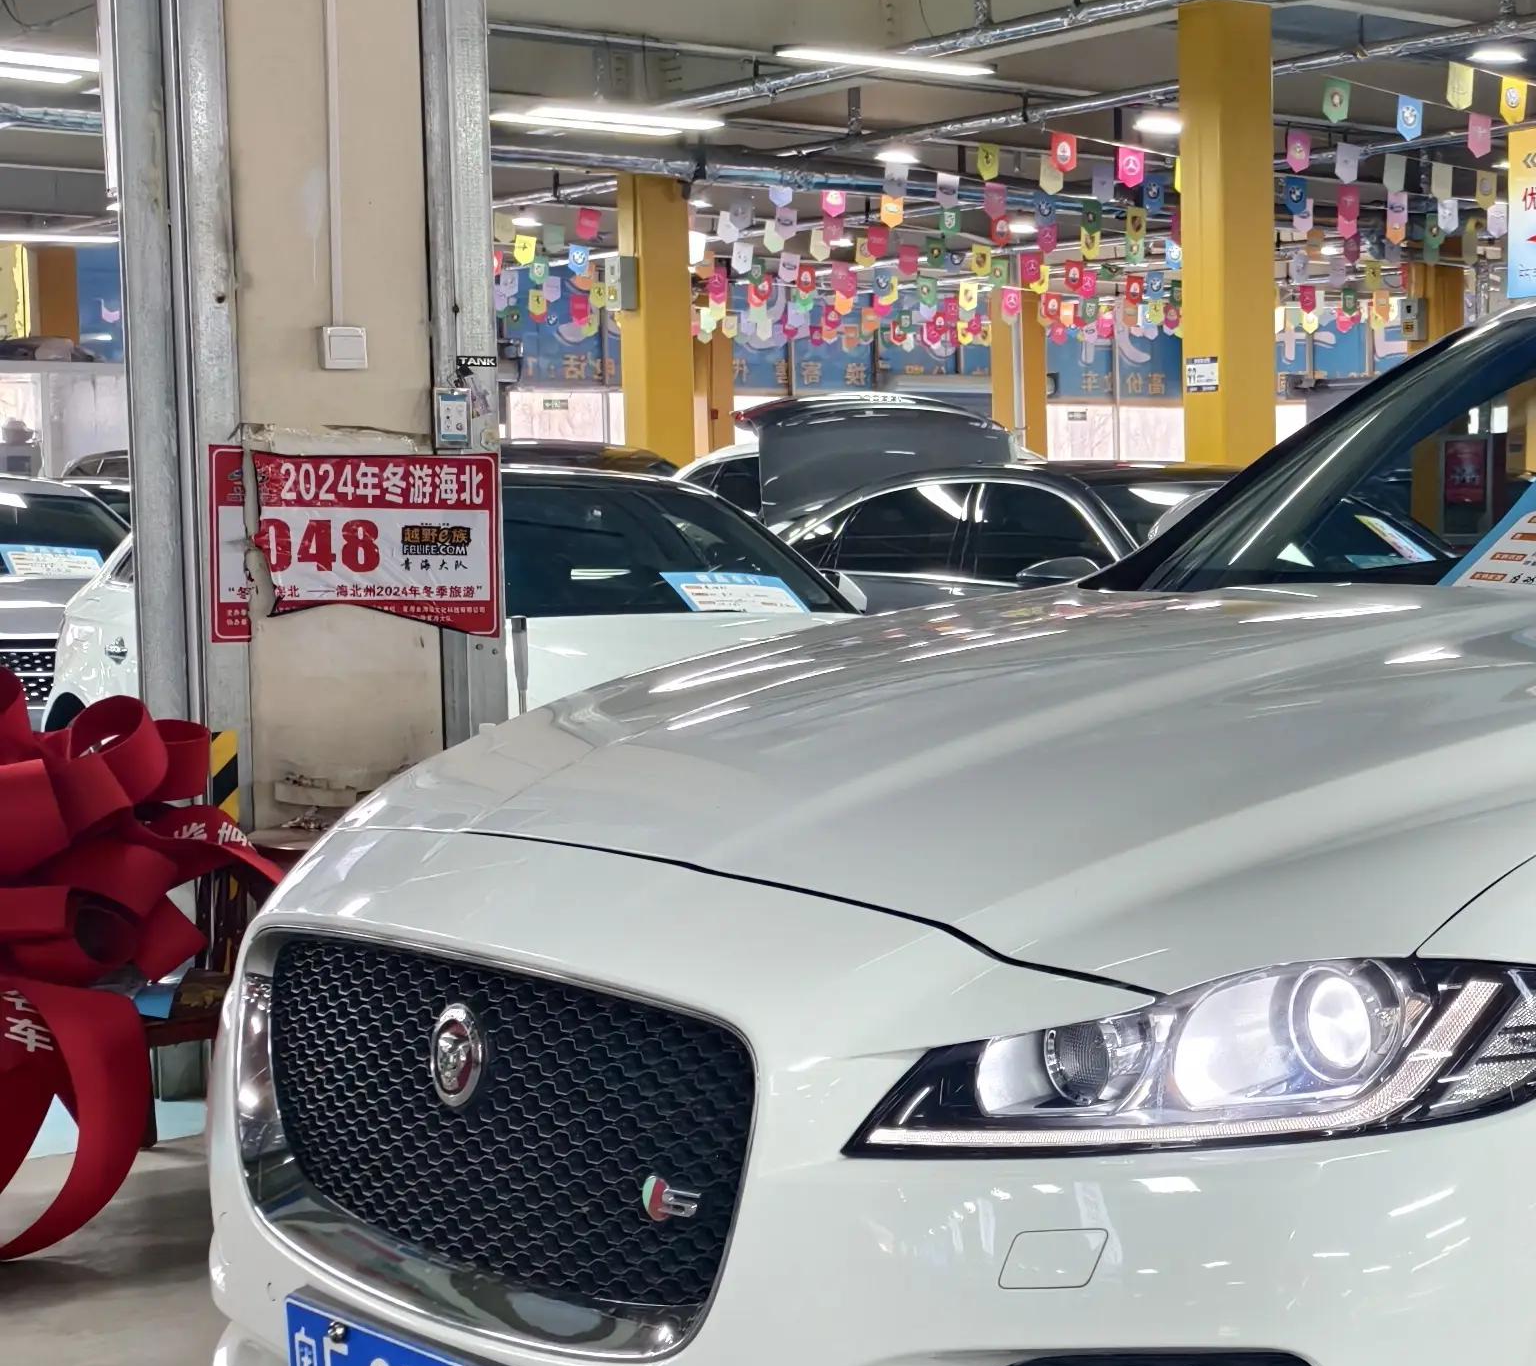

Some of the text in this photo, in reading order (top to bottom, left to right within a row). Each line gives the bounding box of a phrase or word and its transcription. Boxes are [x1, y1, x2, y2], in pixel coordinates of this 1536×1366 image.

[459, 357, 496, 366] TANK
[279, 461, 485, 505] 2024年冬游海北
